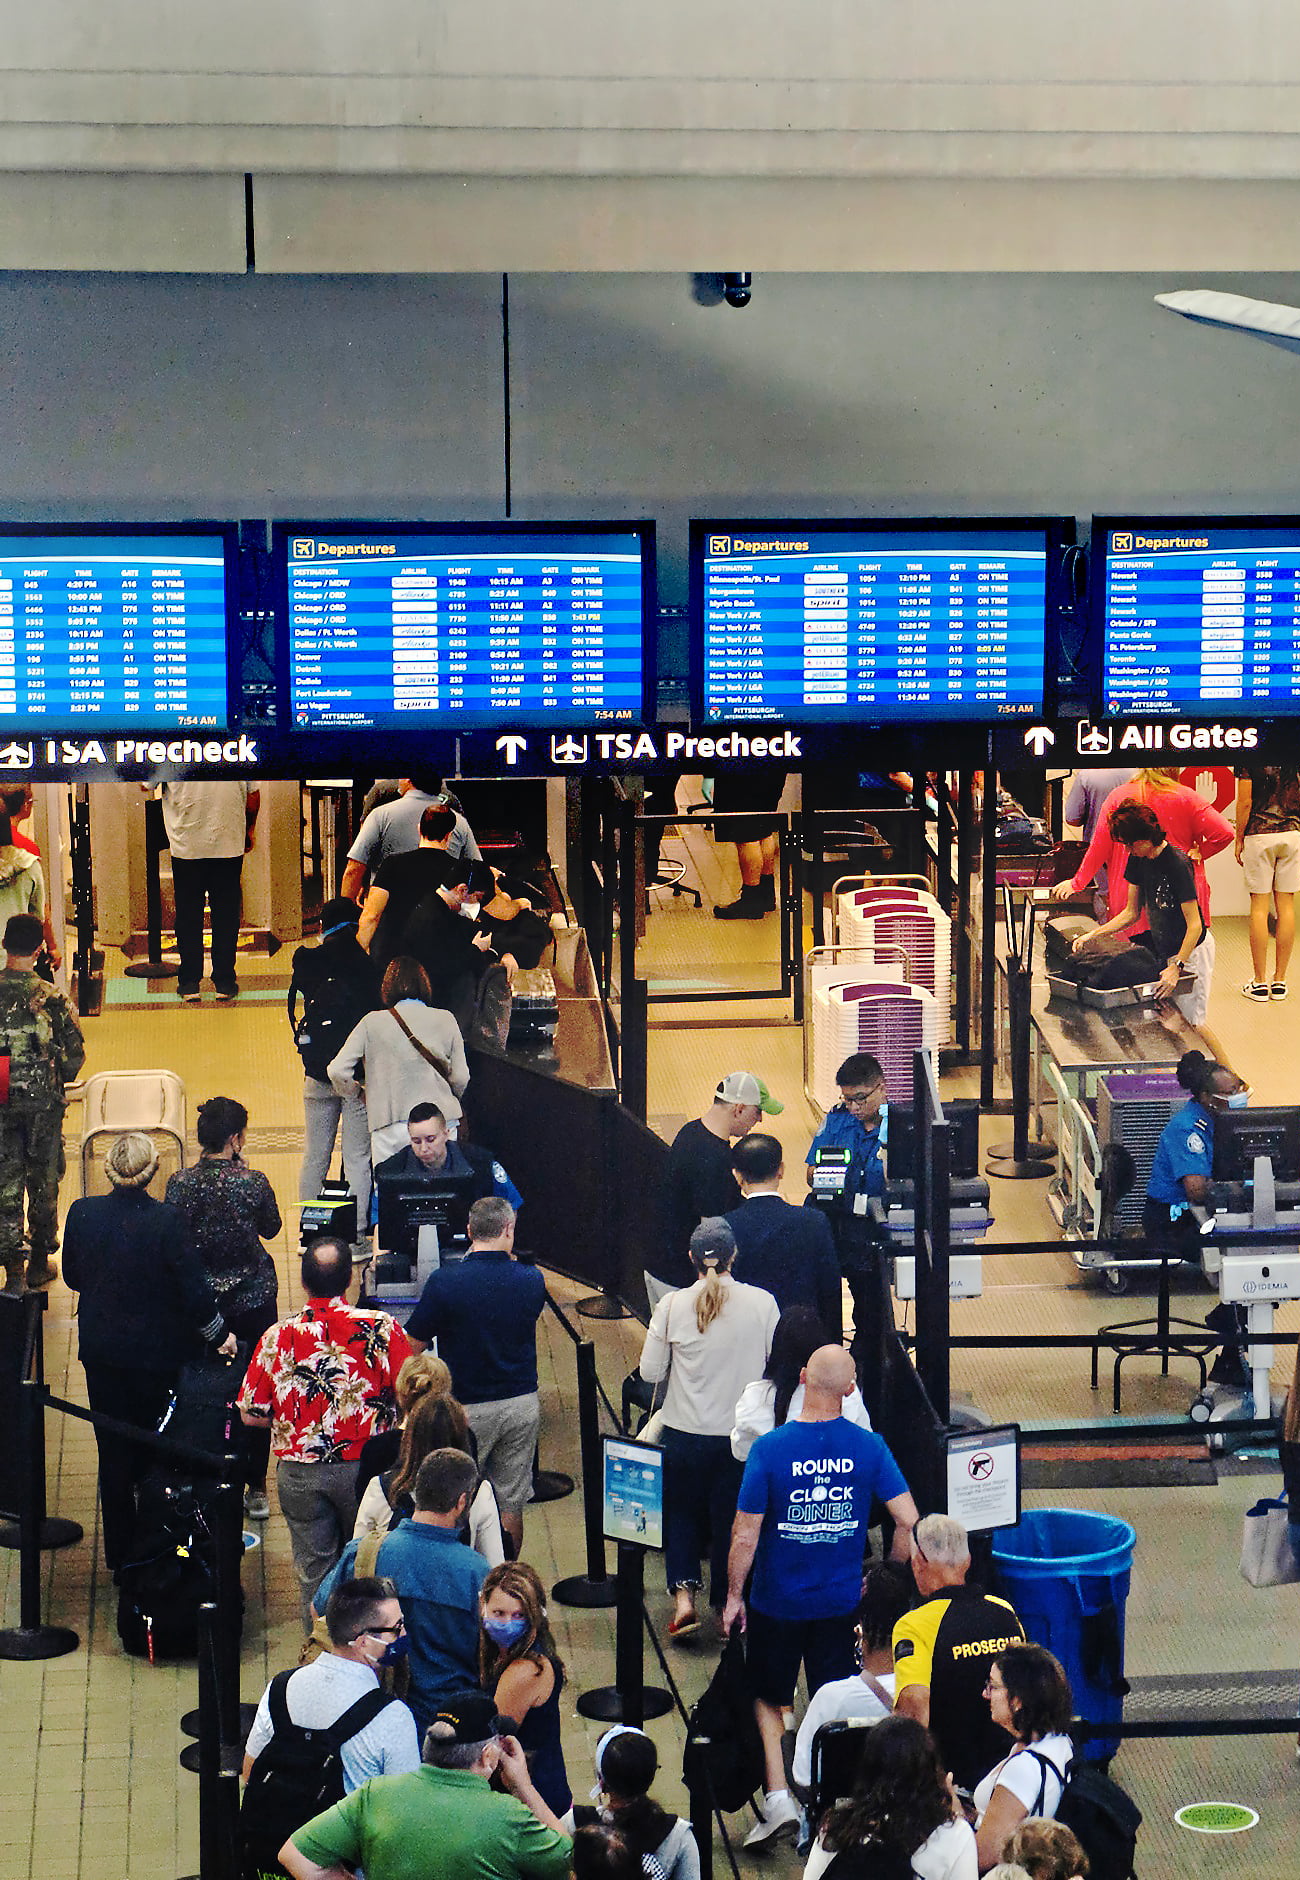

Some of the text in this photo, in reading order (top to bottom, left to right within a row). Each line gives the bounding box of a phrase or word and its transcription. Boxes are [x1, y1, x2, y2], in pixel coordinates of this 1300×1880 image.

[318, 543, 397, 558] Departures
[733, 539, 809, 554] Departures
[1136, 536, 1209, 552] Departures
[293, 568, 338, 576] DESTINATION
[294, 580, 322, 588] Chicago
[294, 592, 322, 600] Chicago
[595, 710, 631, 719] 7:54 AM
[998, 705, 1016, 713] 7:54
[178, 716, 216, 725] 7:54 AM
[1119, 725, 1258, 749] All Gates
[116, 735, 258, 763] Precheck
[596, 731, 802, 760] TSA Precheck
[792, 1459, 854, 1476] ROUND
[814, 1475, 831, 1484] the
[790, 1486, 854, 1502] CLOCK
[787, 1502, 853, 1522] DINER
